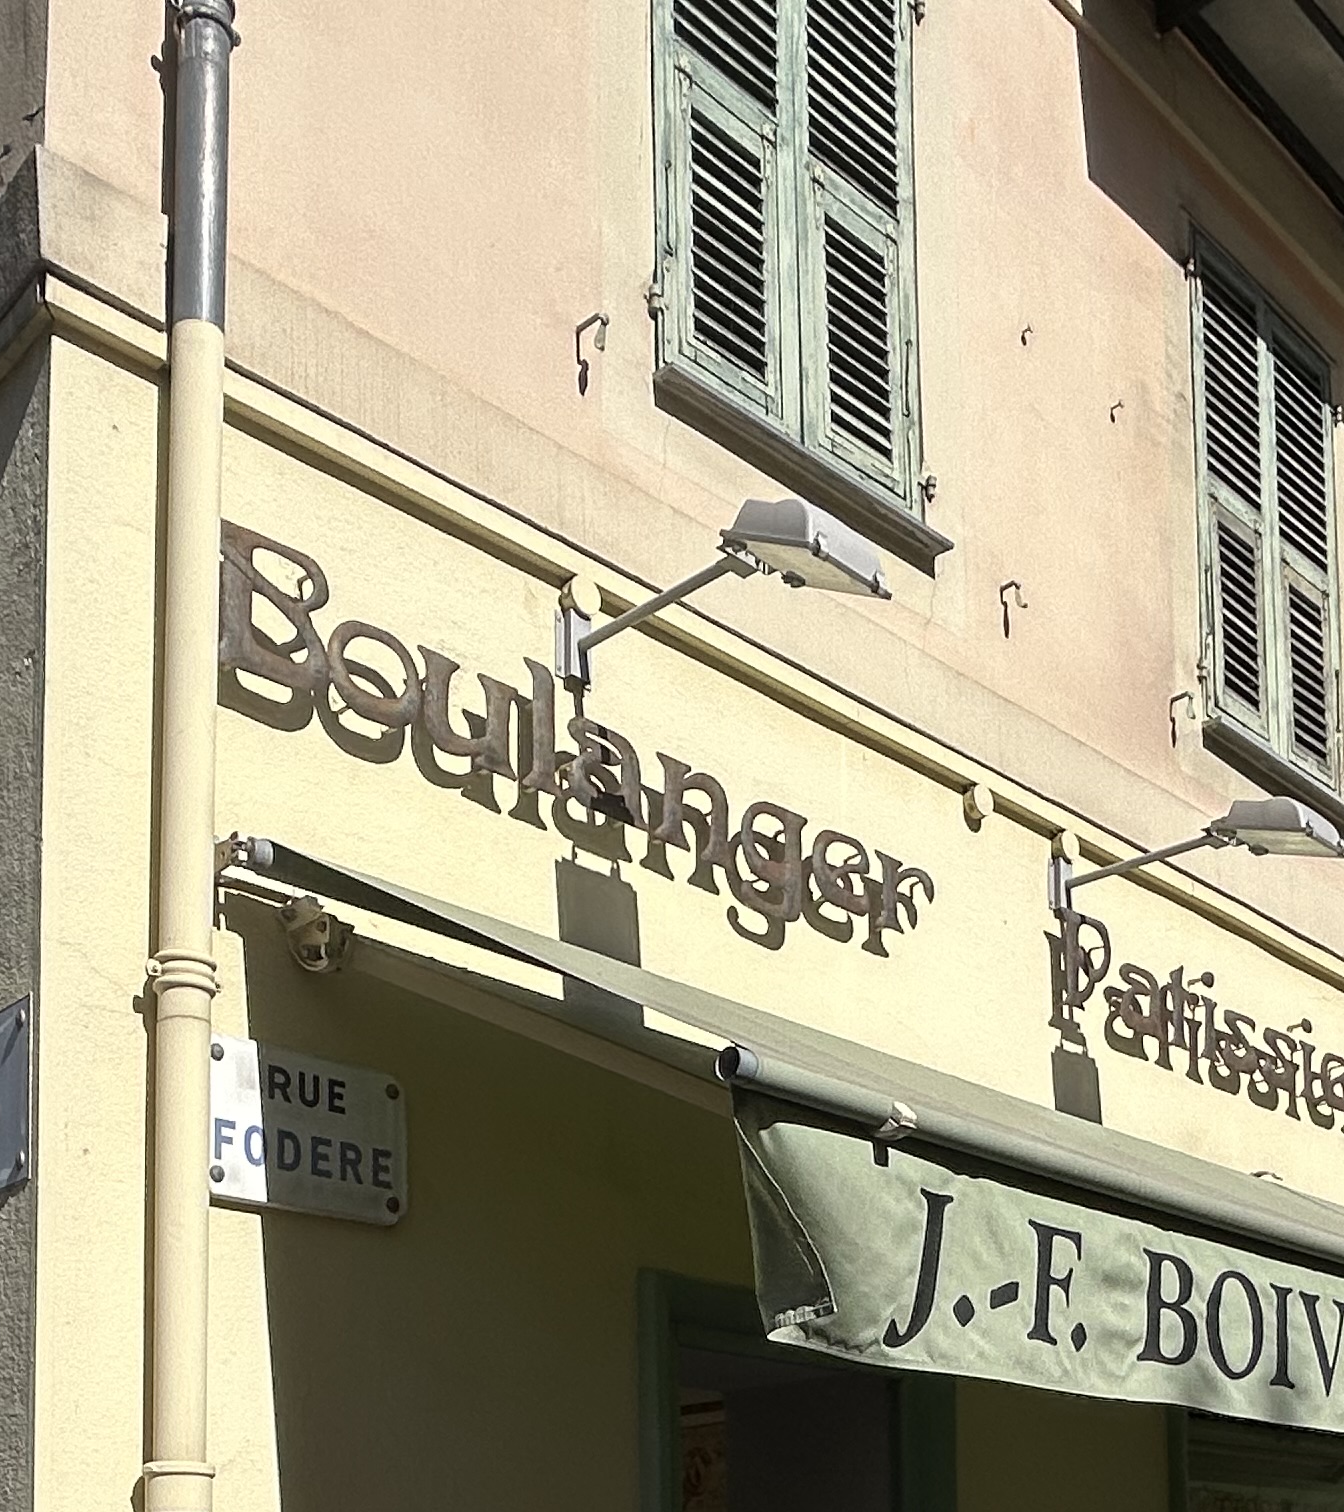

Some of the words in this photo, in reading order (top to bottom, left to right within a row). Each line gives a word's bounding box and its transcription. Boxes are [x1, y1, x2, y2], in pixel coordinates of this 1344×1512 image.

[219, 519, 935, 922] Boulanger
[267, 1065, 346, 1114] RUE
[213, 1118, 392, 1189] FODERE
[882, 1187, 1088, 1352] J.-F.
